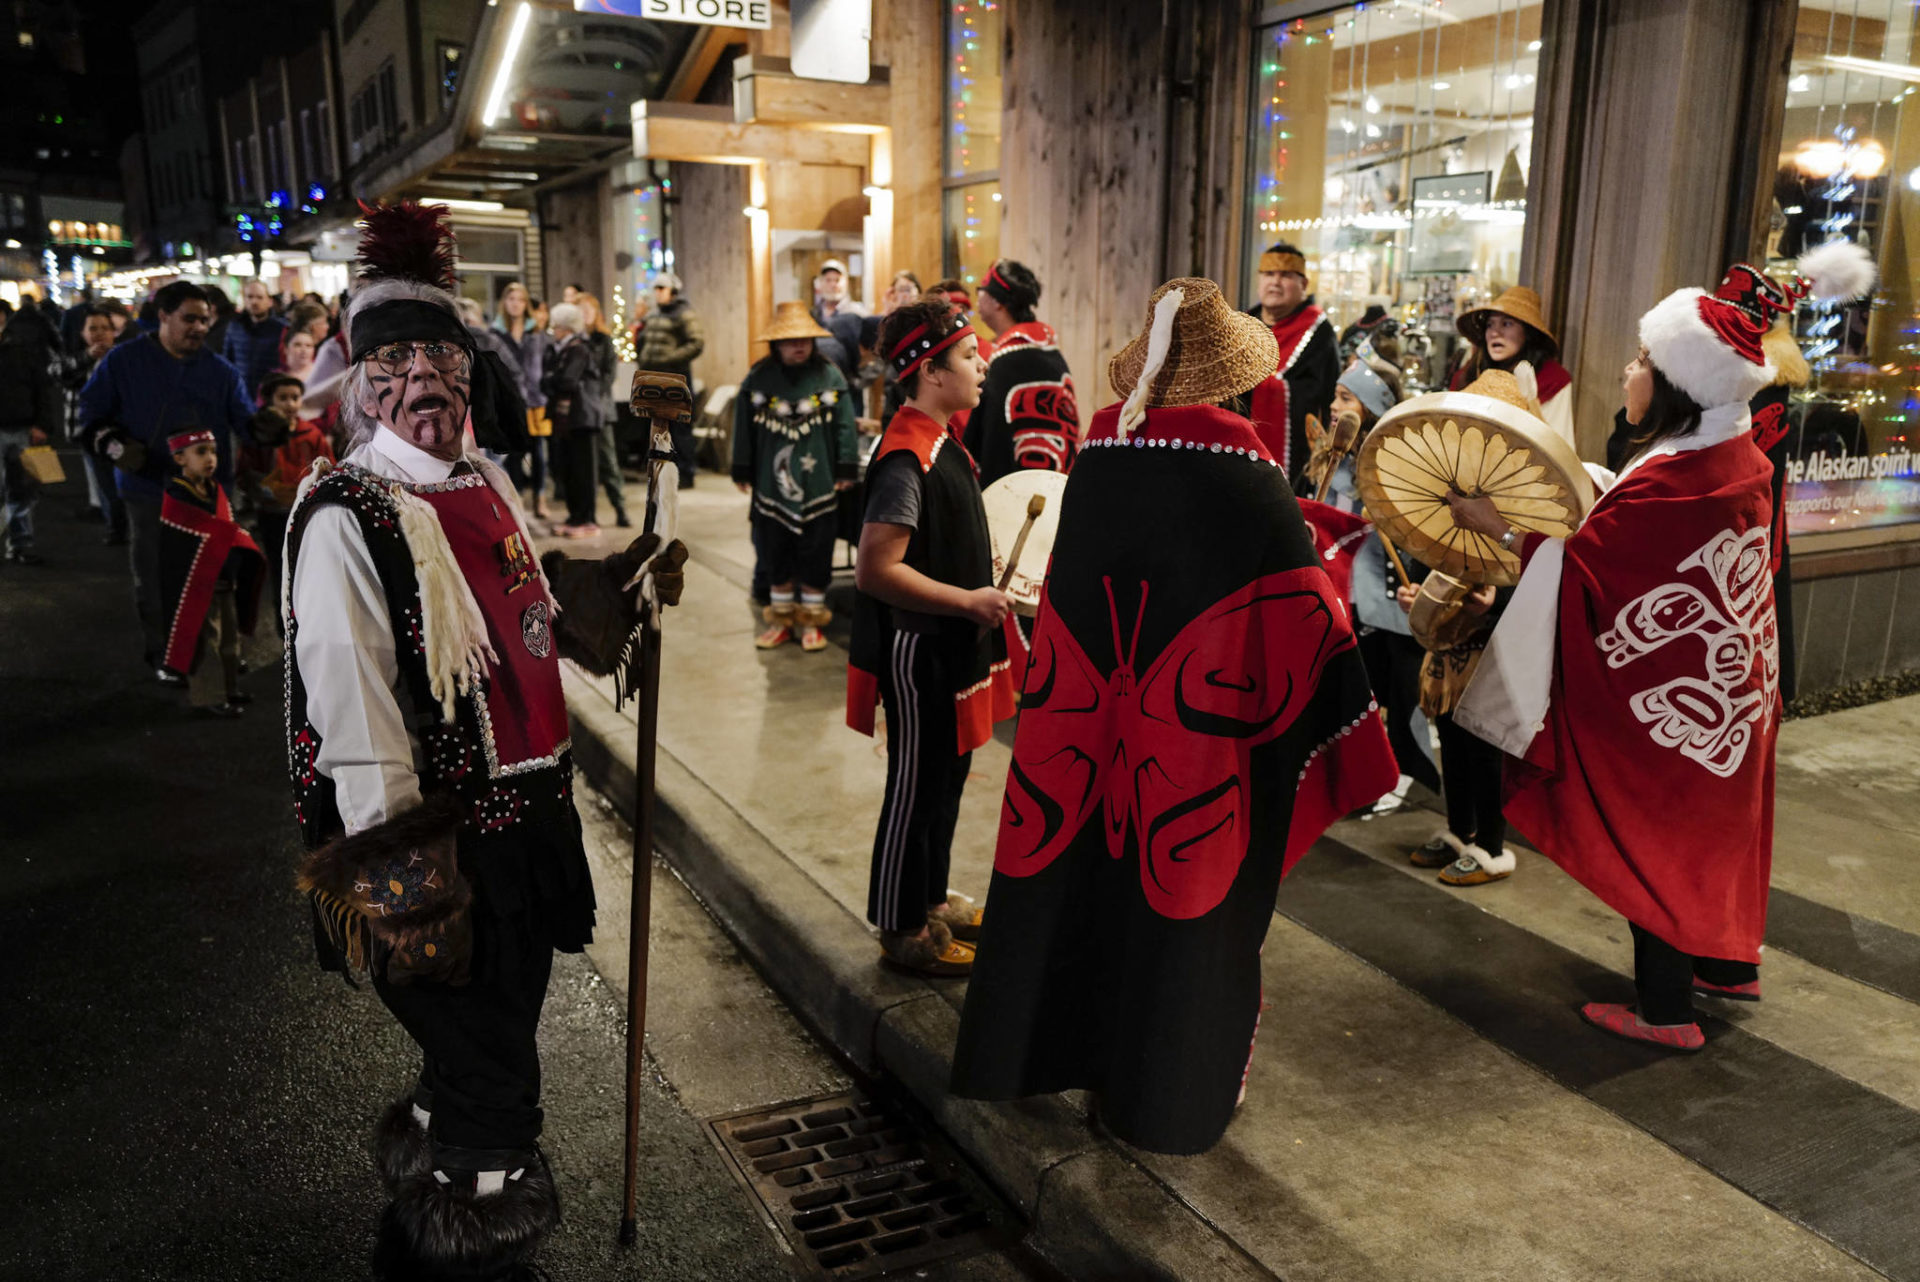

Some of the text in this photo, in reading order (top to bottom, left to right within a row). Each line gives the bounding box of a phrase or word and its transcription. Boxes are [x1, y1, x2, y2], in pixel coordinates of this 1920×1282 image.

[650, 0, 767, 23] STORE
[1786, 452, 1804, 483] he
[1804, 449, 1869, 482] Alaskan
[1870, 446, 1910, 483] spirit
